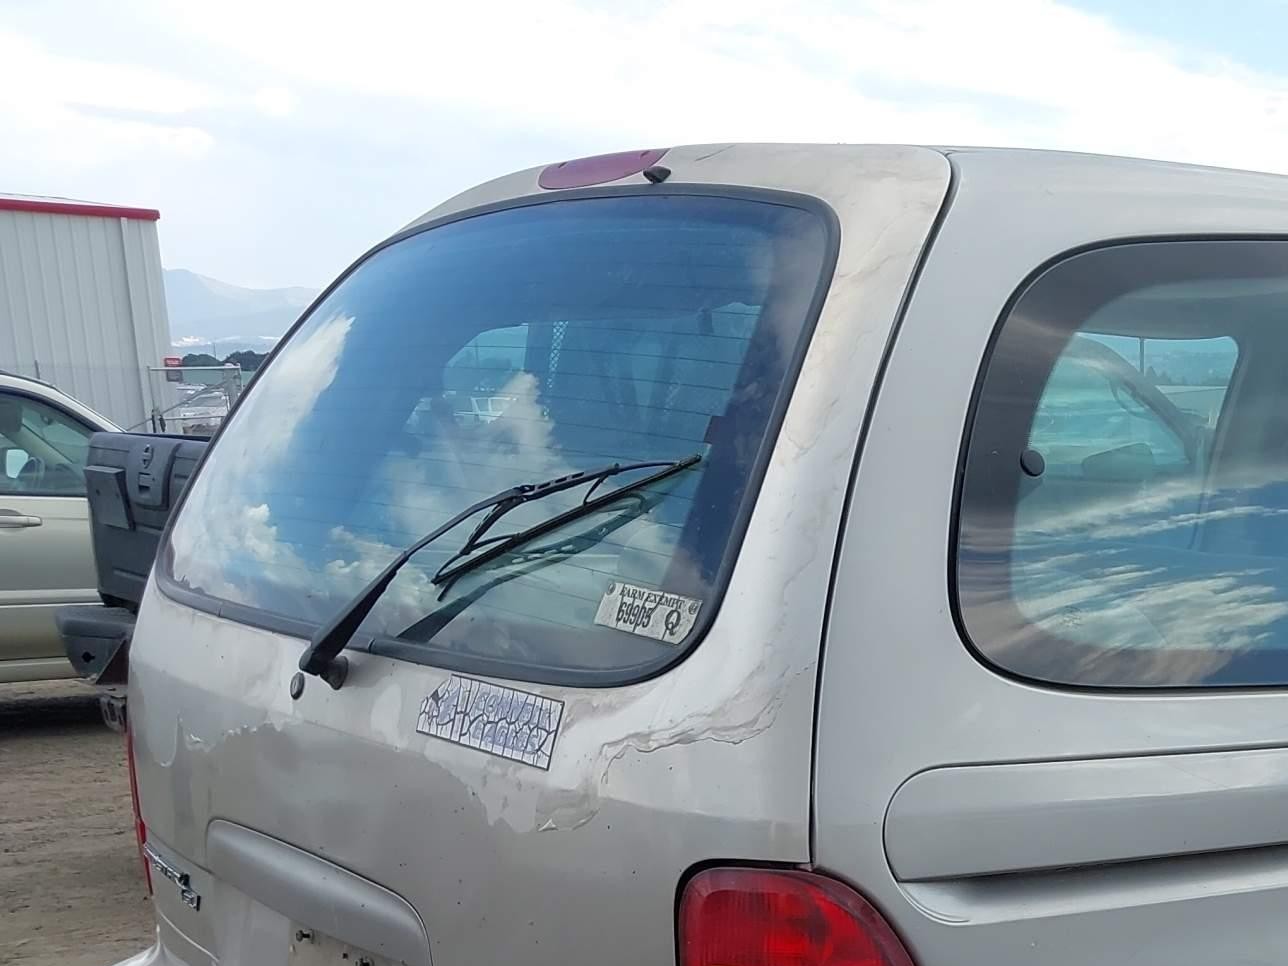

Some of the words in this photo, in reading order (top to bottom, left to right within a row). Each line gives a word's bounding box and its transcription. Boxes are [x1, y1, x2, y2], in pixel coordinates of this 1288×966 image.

[619, 586, 645, 602] FARM
[645, 592, 685, 608] EXEMPT
[665, 609, 681, 636] Q
